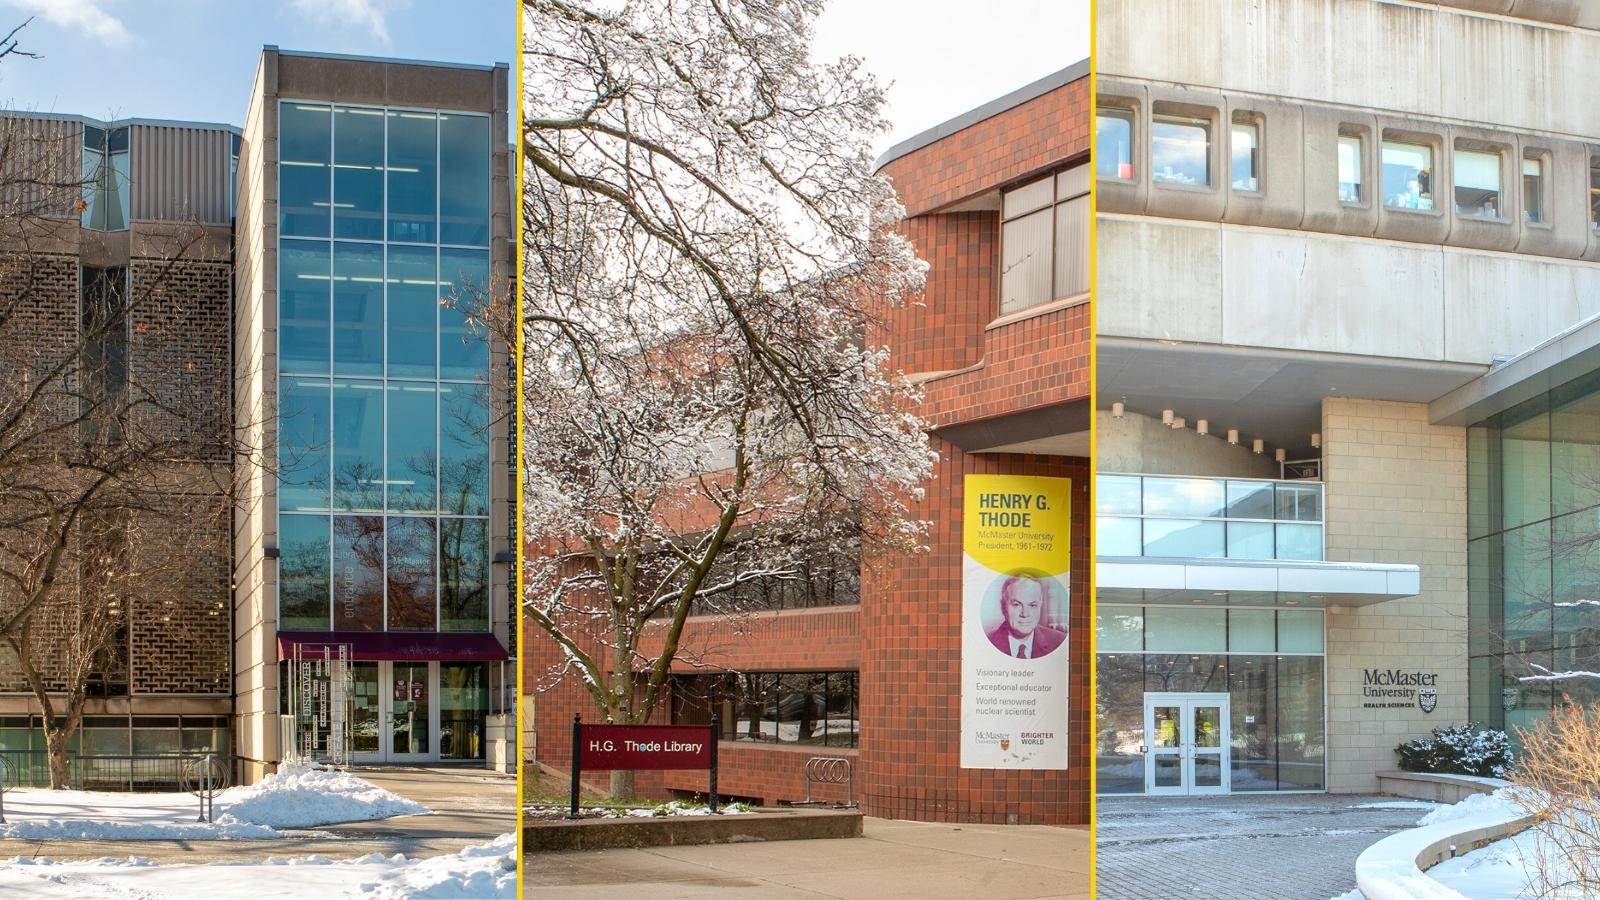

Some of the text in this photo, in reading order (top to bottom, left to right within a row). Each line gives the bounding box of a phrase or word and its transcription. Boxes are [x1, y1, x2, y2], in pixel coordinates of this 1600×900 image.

[979, 493, 1050, 511] HENRY G.
[979, 512, 1031, 528] THODE
[978, 531, 1054, 541] McMaster University
[978, 541, 1014, 551] President,
[976, 668, 1034, 678] Visionary leader
[1363, 668, 1438, 686] McMaster
[303, 661, 311, 717] DISCOVER
[976, 682, 1018, 692] Exceptional
[1363, 686, 1416, 700] University
[976, 697, 1036, 706] World renowned
[976, 707, 1036, 716] nuclear scientist
[589, 740, 617, 752] H.G.
[664, 740, 702, 754] Library
